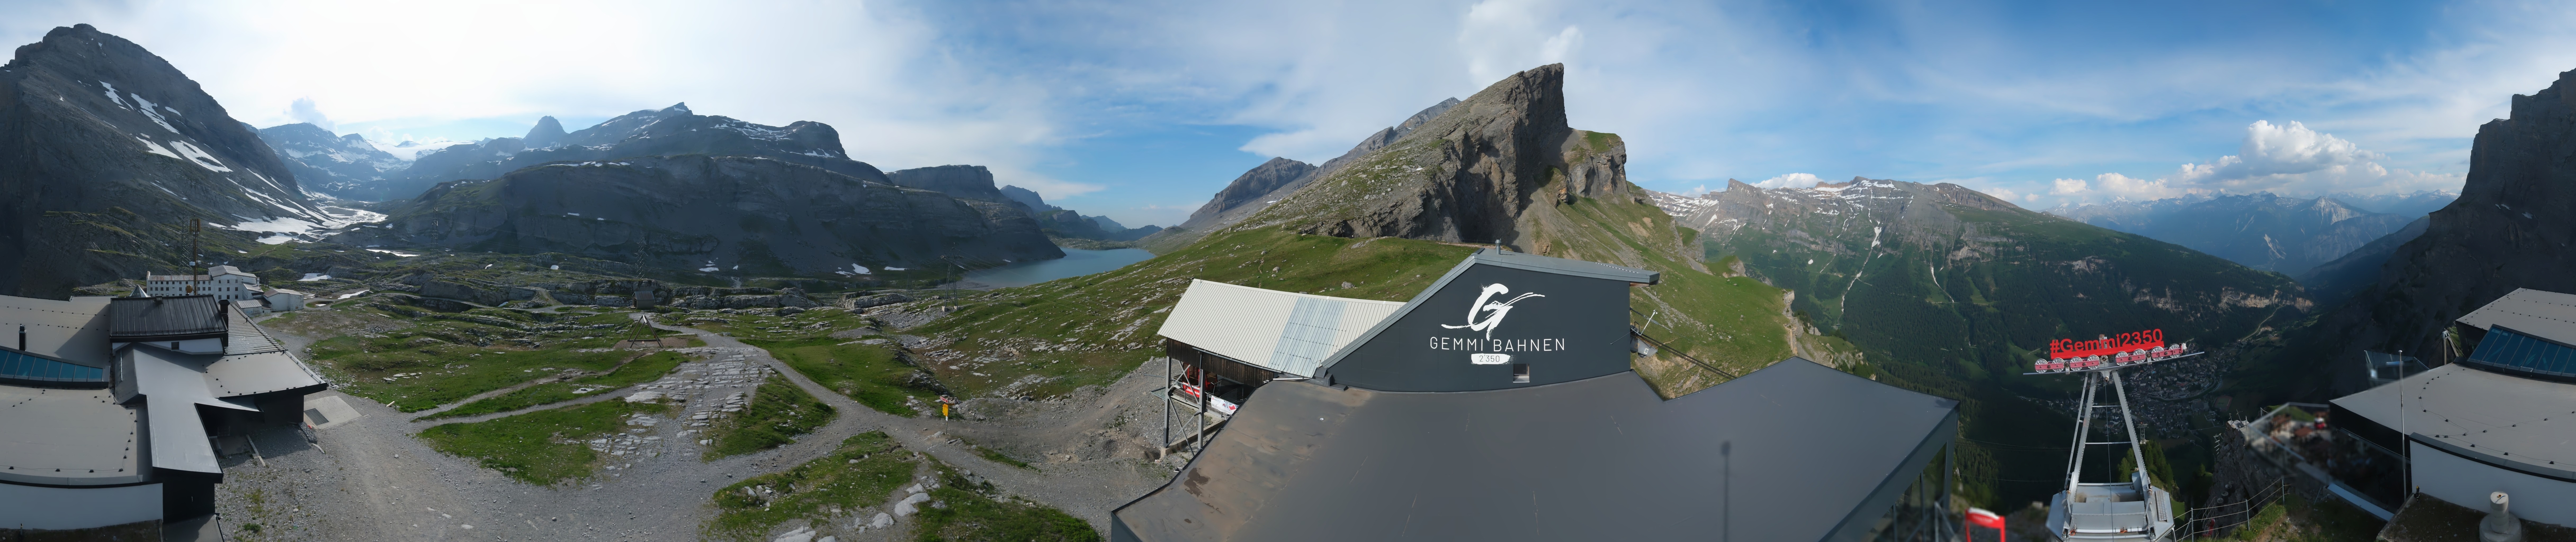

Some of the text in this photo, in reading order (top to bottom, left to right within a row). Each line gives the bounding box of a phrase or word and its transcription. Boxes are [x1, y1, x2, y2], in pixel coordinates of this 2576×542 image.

[1430, 337, 1564, 352] GEMMI BAHNEN
[2050, 329, 2163, 353] #Gemmi2350
